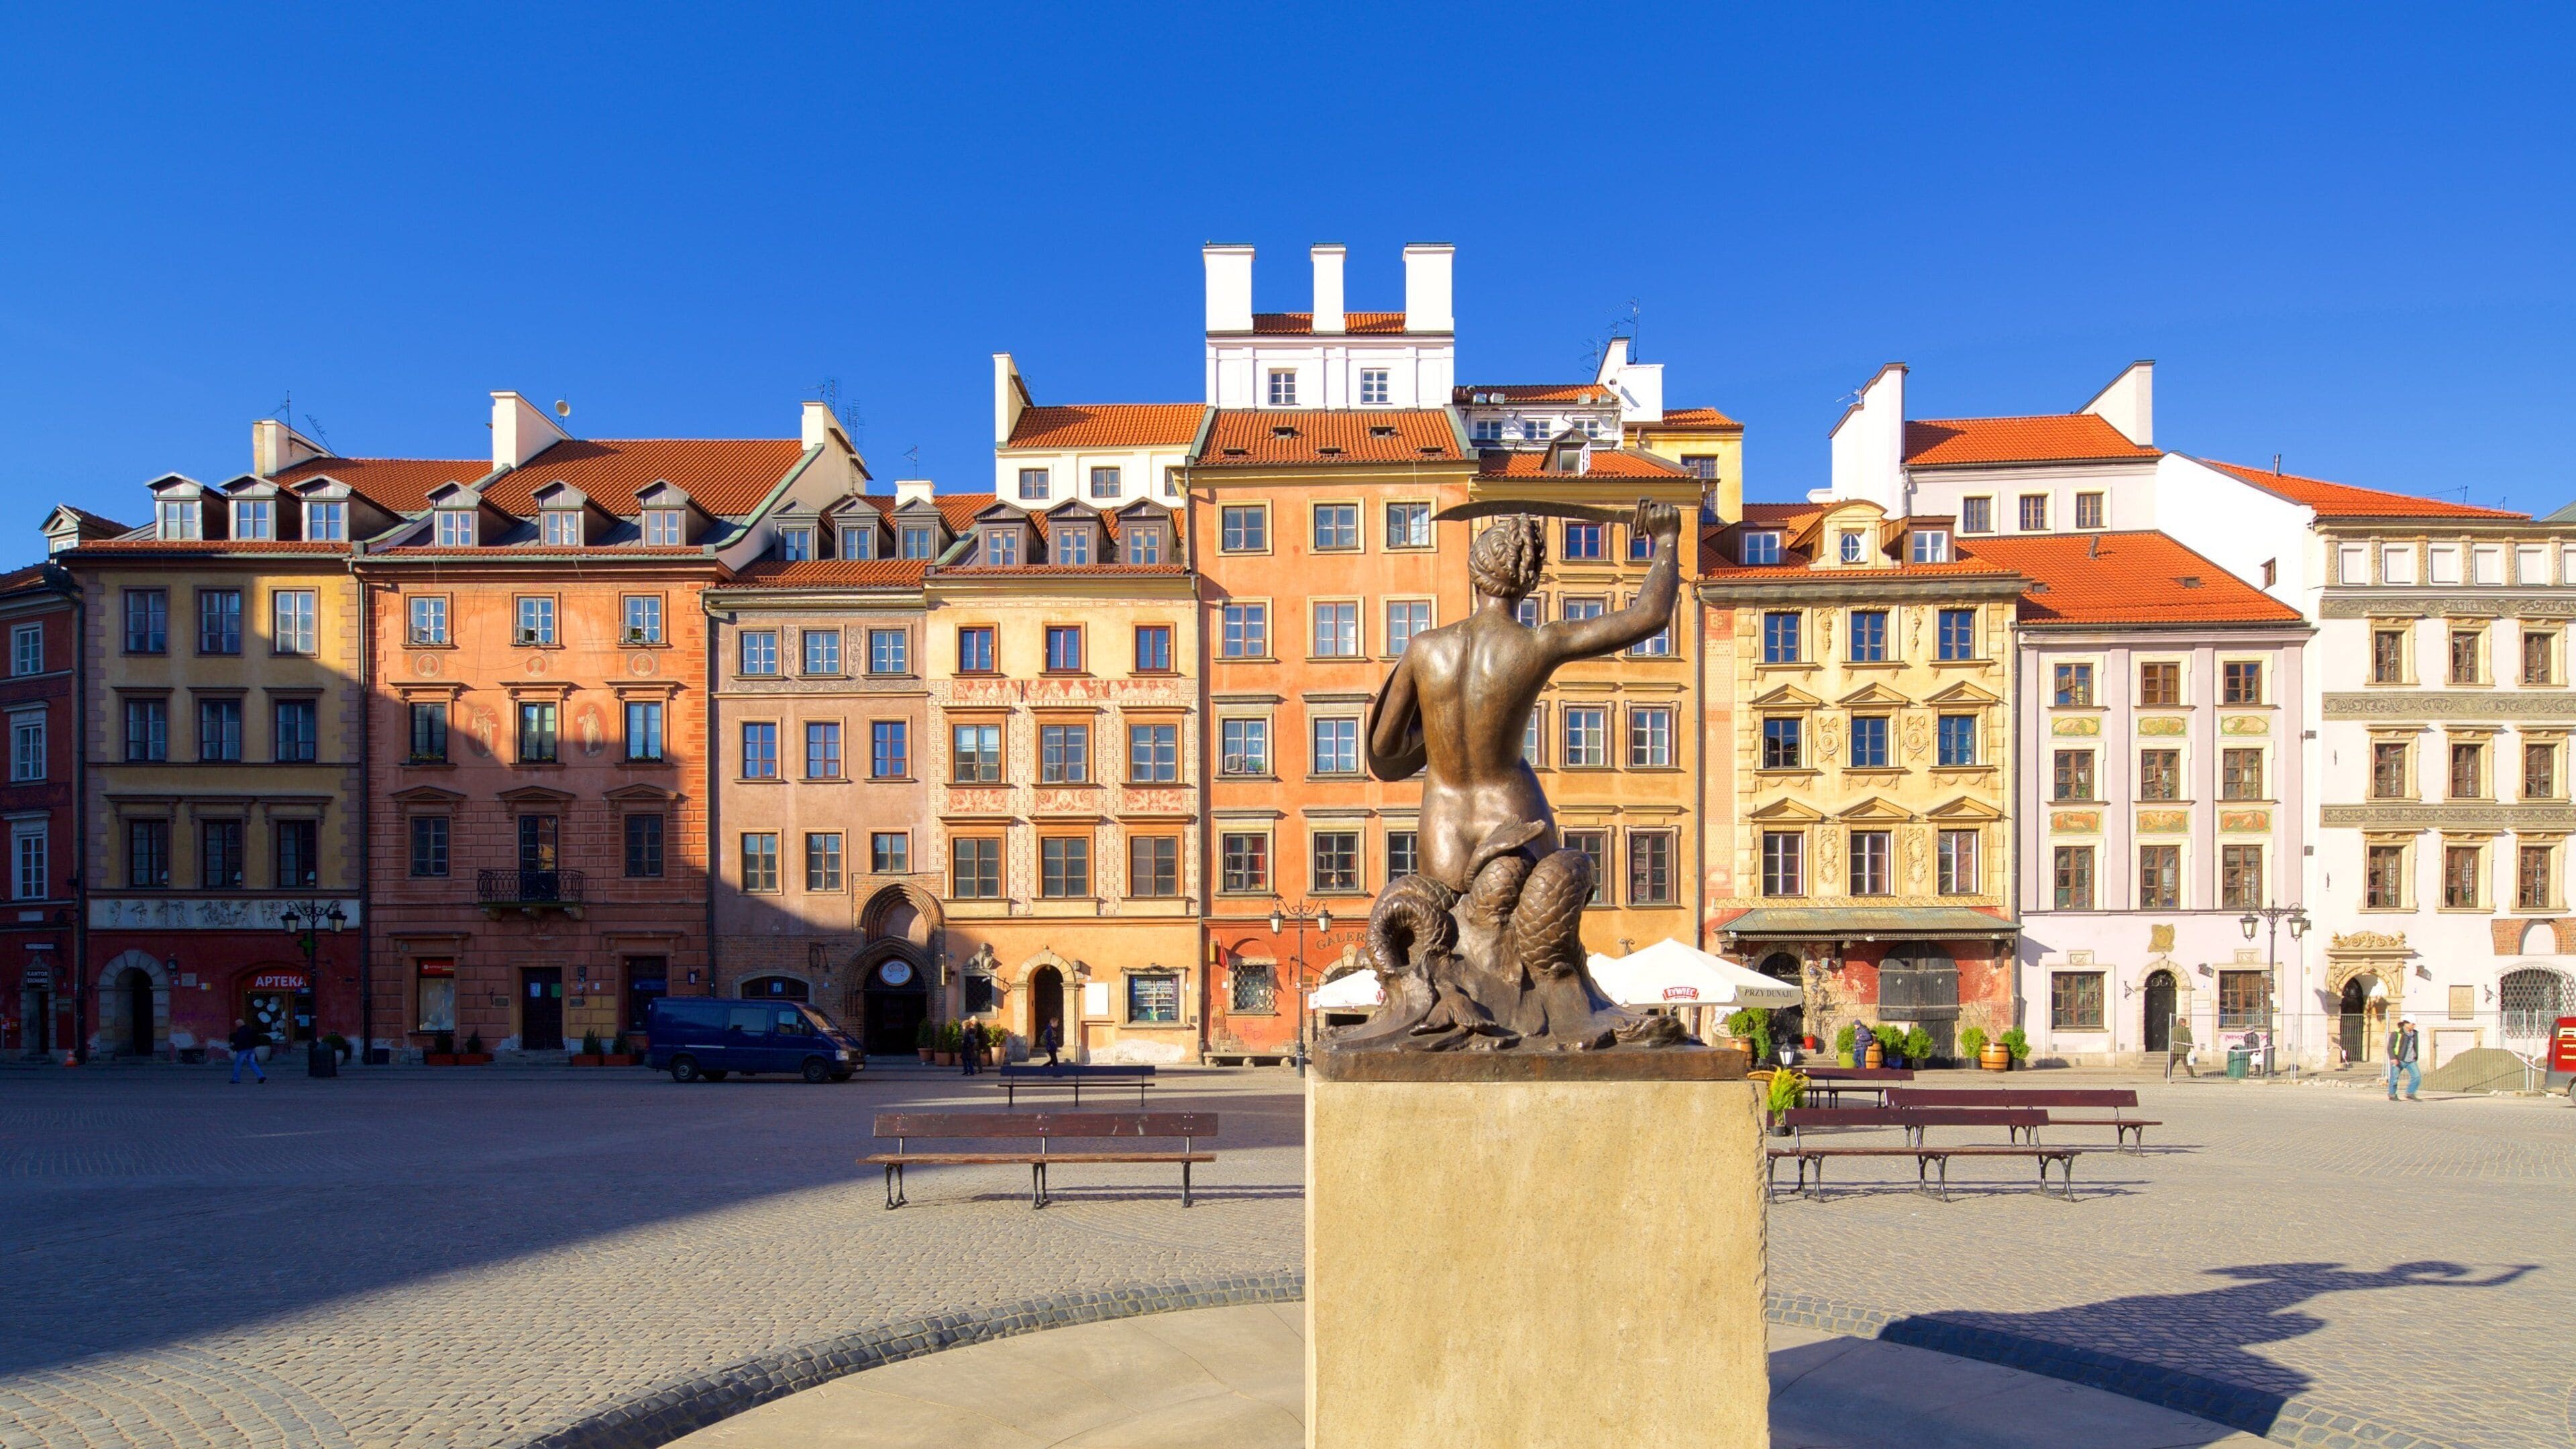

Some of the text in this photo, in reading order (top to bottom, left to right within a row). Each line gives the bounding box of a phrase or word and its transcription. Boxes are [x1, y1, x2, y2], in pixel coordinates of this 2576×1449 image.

[255, 975, 307, 987] APTEKA
[1744, 989, 1793, 998] PRZY DUNAJU
